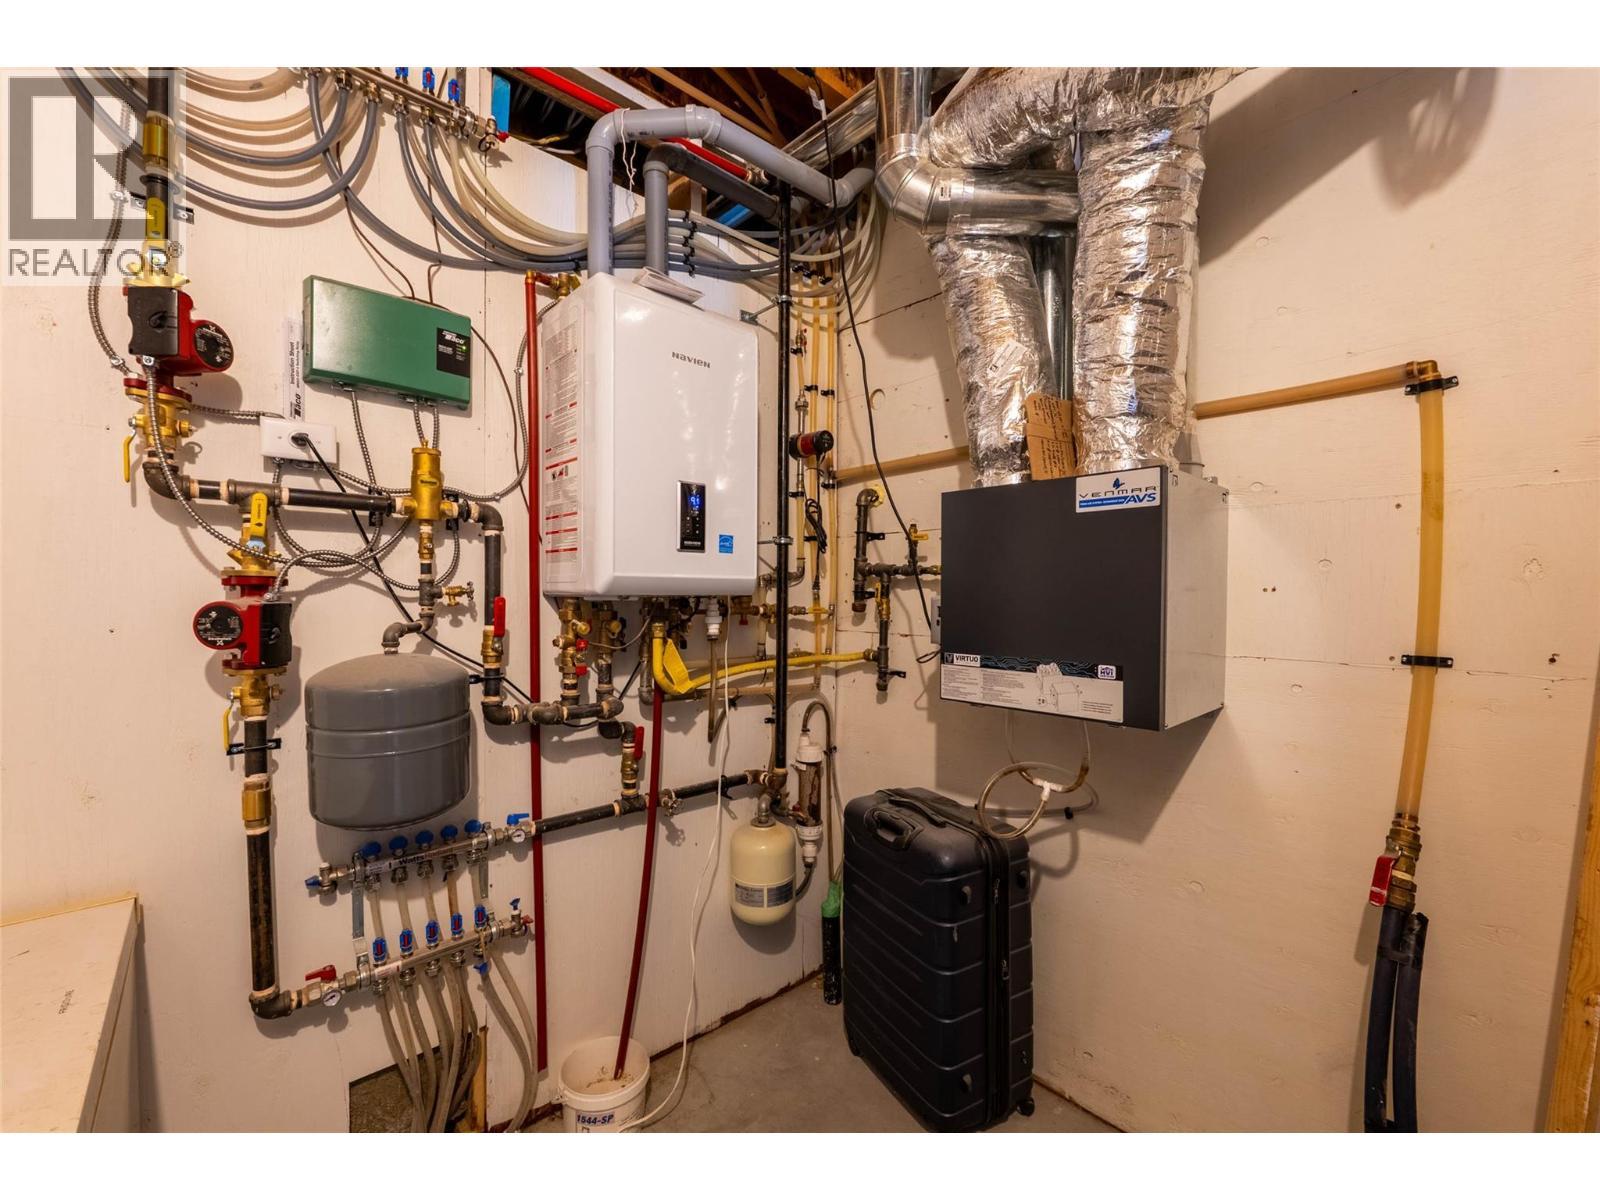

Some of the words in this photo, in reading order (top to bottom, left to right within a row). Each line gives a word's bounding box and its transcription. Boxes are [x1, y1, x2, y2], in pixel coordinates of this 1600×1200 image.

[1079, 485, 1157, 498] VENMAR
[1126, 492, 1156, 505] AVS
[955, 655, 979, 663] VIRTUO
[577, 1114, 614, 1125] 1544-SP
